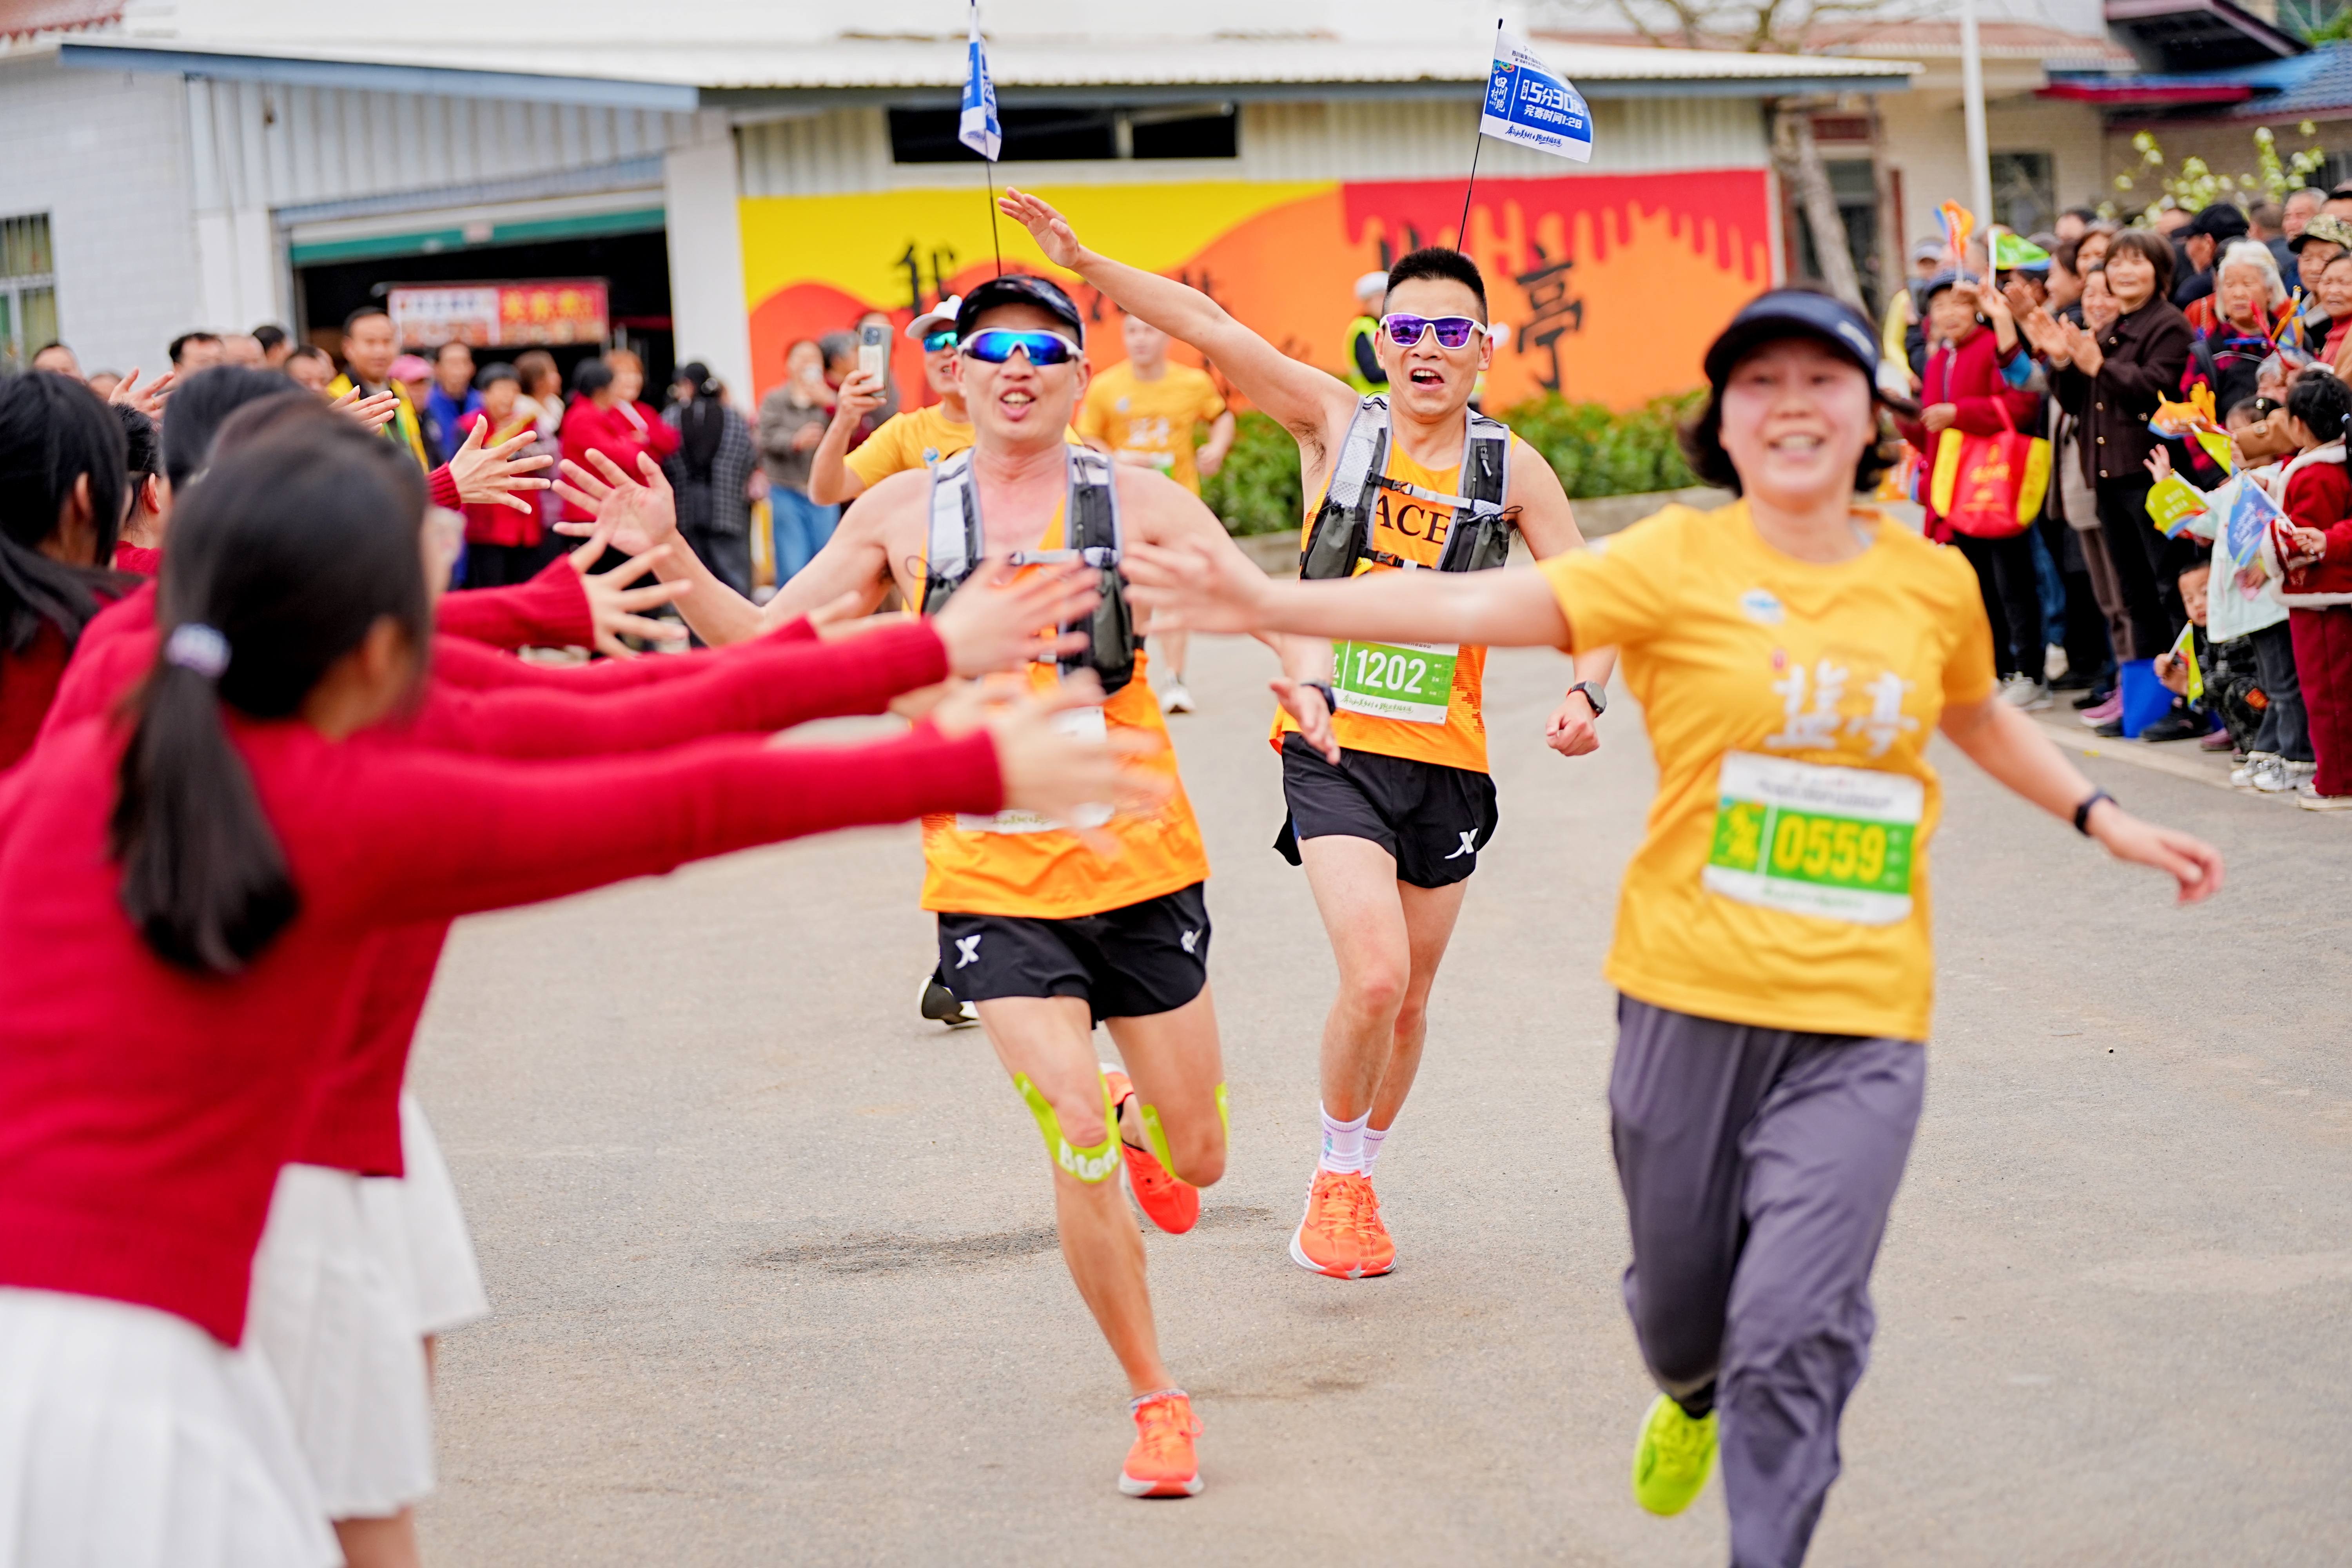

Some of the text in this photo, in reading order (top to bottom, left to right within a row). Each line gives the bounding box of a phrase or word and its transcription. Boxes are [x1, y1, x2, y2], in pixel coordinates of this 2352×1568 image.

[1524, 104, 1583, 129] 完赛时间1:28
[1356, 649, 1426, 694] 1202
[1773, 814, 1887, 883] 0559
